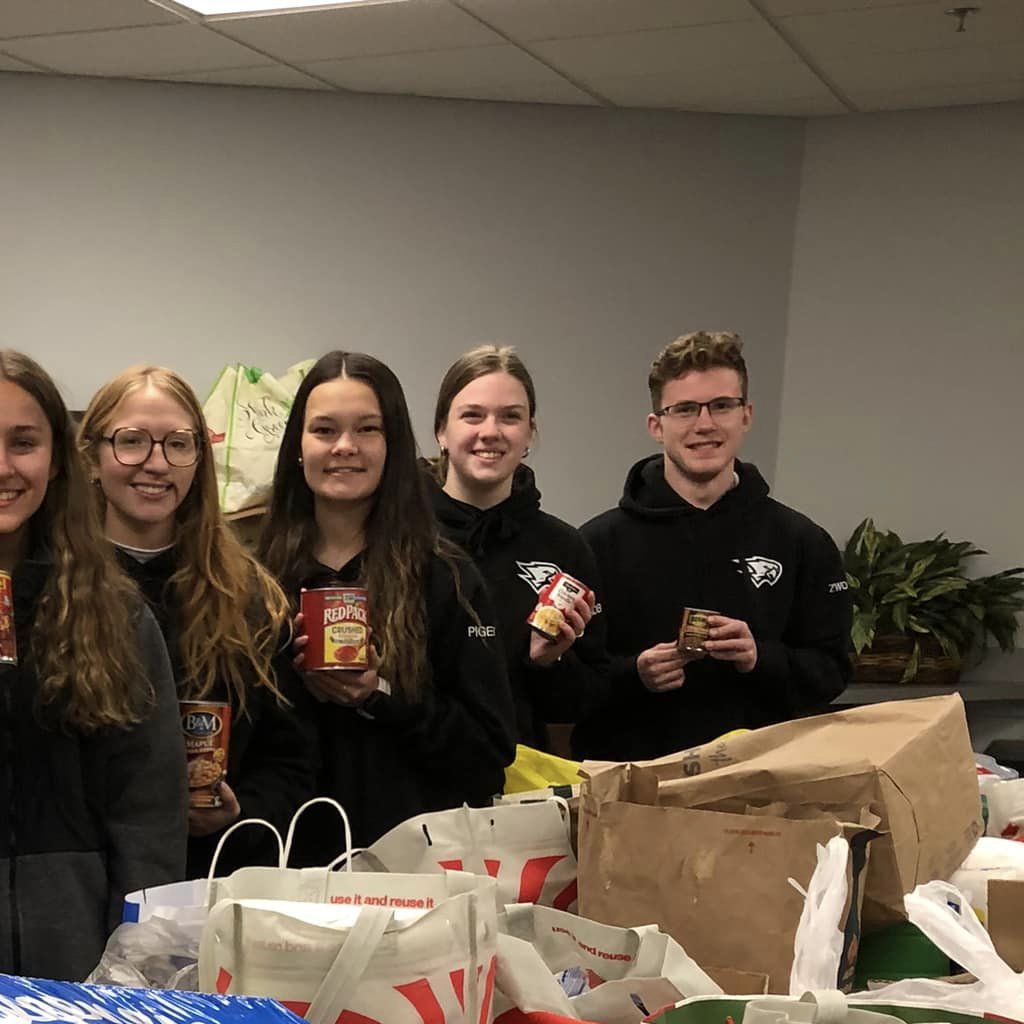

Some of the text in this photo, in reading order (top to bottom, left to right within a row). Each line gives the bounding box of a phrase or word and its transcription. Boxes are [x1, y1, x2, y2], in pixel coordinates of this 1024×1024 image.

[330, 894, 434, 909] use it and reuse it
